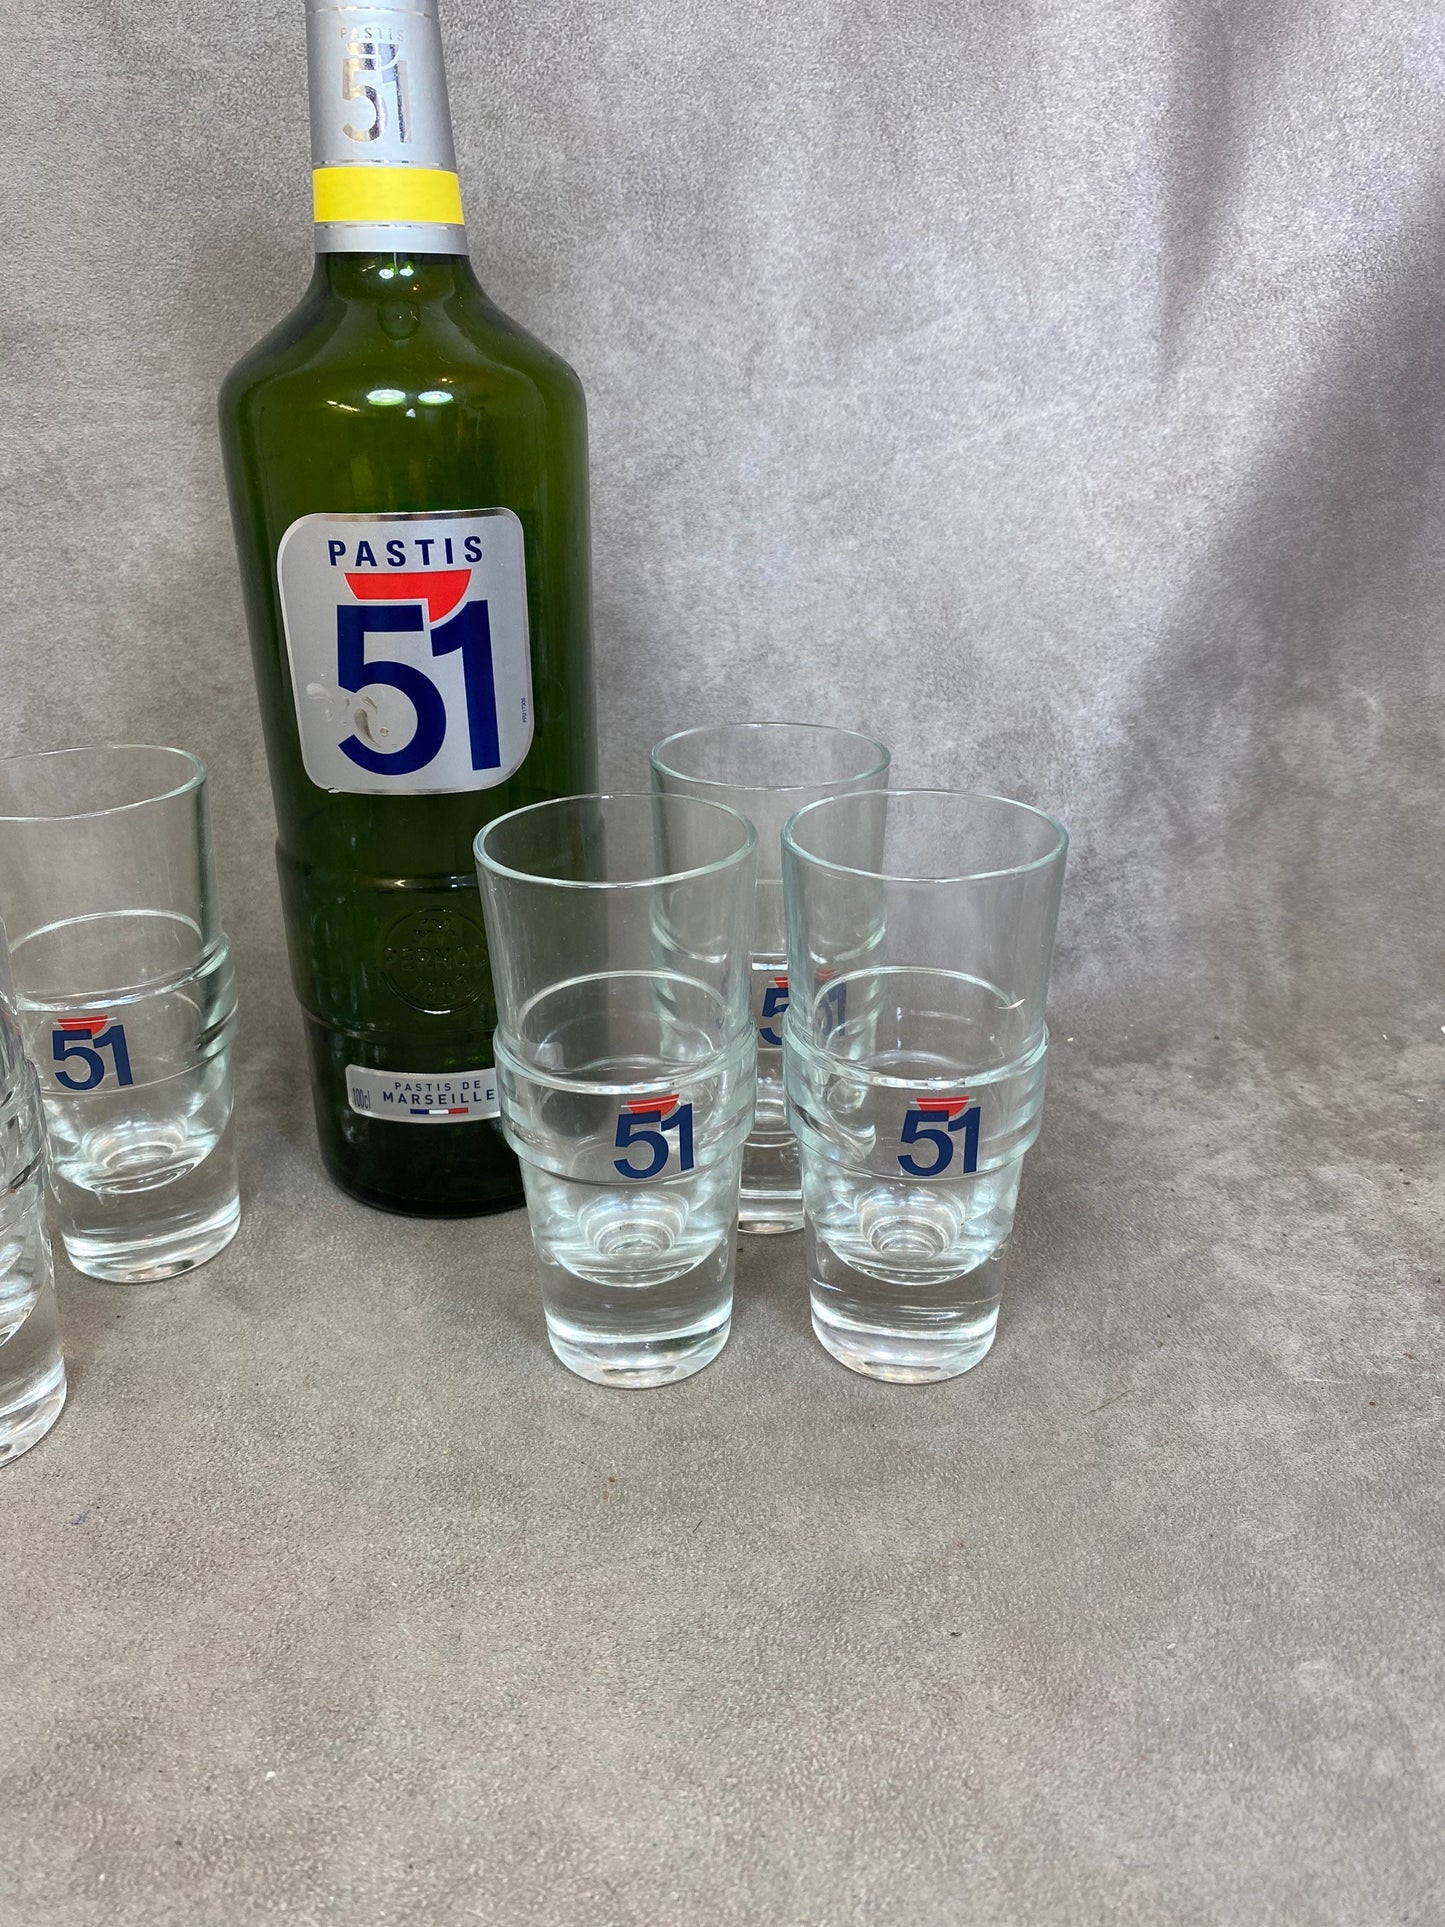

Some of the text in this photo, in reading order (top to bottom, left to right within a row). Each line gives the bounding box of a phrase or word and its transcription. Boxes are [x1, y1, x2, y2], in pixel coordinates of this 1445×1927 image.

[342, 57, 413, 144] 51
[327, 535, 483, 567] PASTIS
[336, 599, 501, 776] 51
[52, 1023, 134, 1091] 51
[394, 1080, 481, 1092] PASTIS DE
[352, 1087, 371, 1110] 100cl
[382, 1088, 495, 1105] MARSEILLE
[613, 1102, 695, 1180] 51
[897, 1106, 982, 1177] 51
